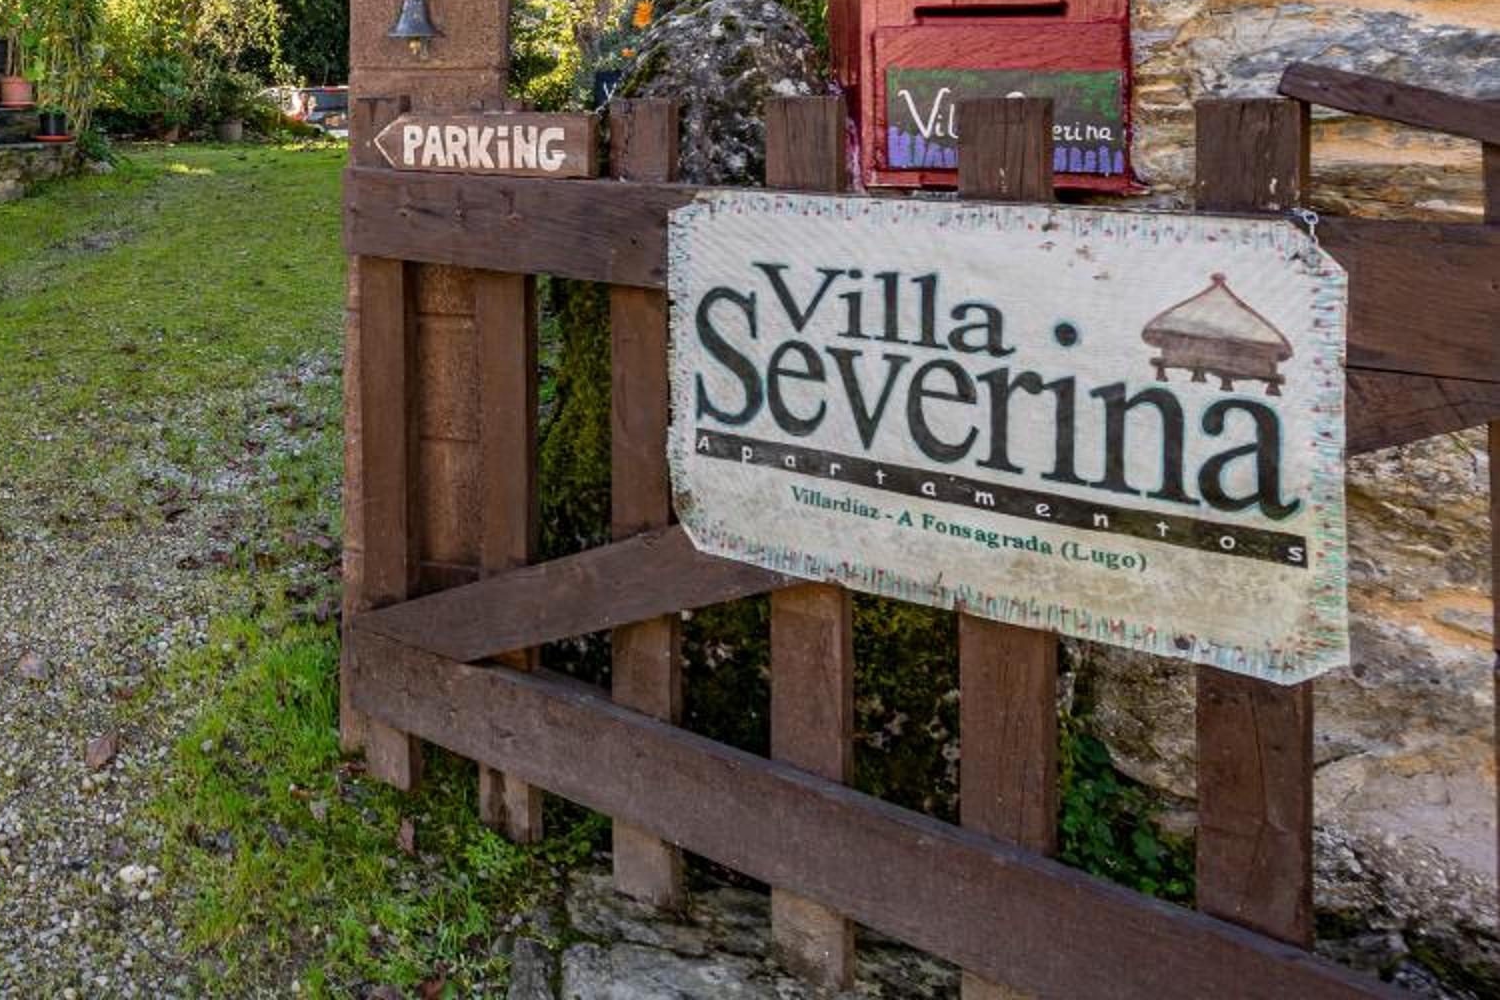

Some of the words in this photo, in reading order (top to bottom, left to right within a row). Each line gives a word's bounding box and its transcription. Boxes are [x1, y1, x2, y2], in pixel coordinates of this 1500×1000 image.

[898, 87, 958, 139] Vil
[752, 261, 1017, 359] Villa
[694, 286, 1301, 521] Severina
[897, 510, 913, 528] A
[921, 513, 1053, 555] Fonsagrada
[1060, 540, 1148, 573] (Lugo)
